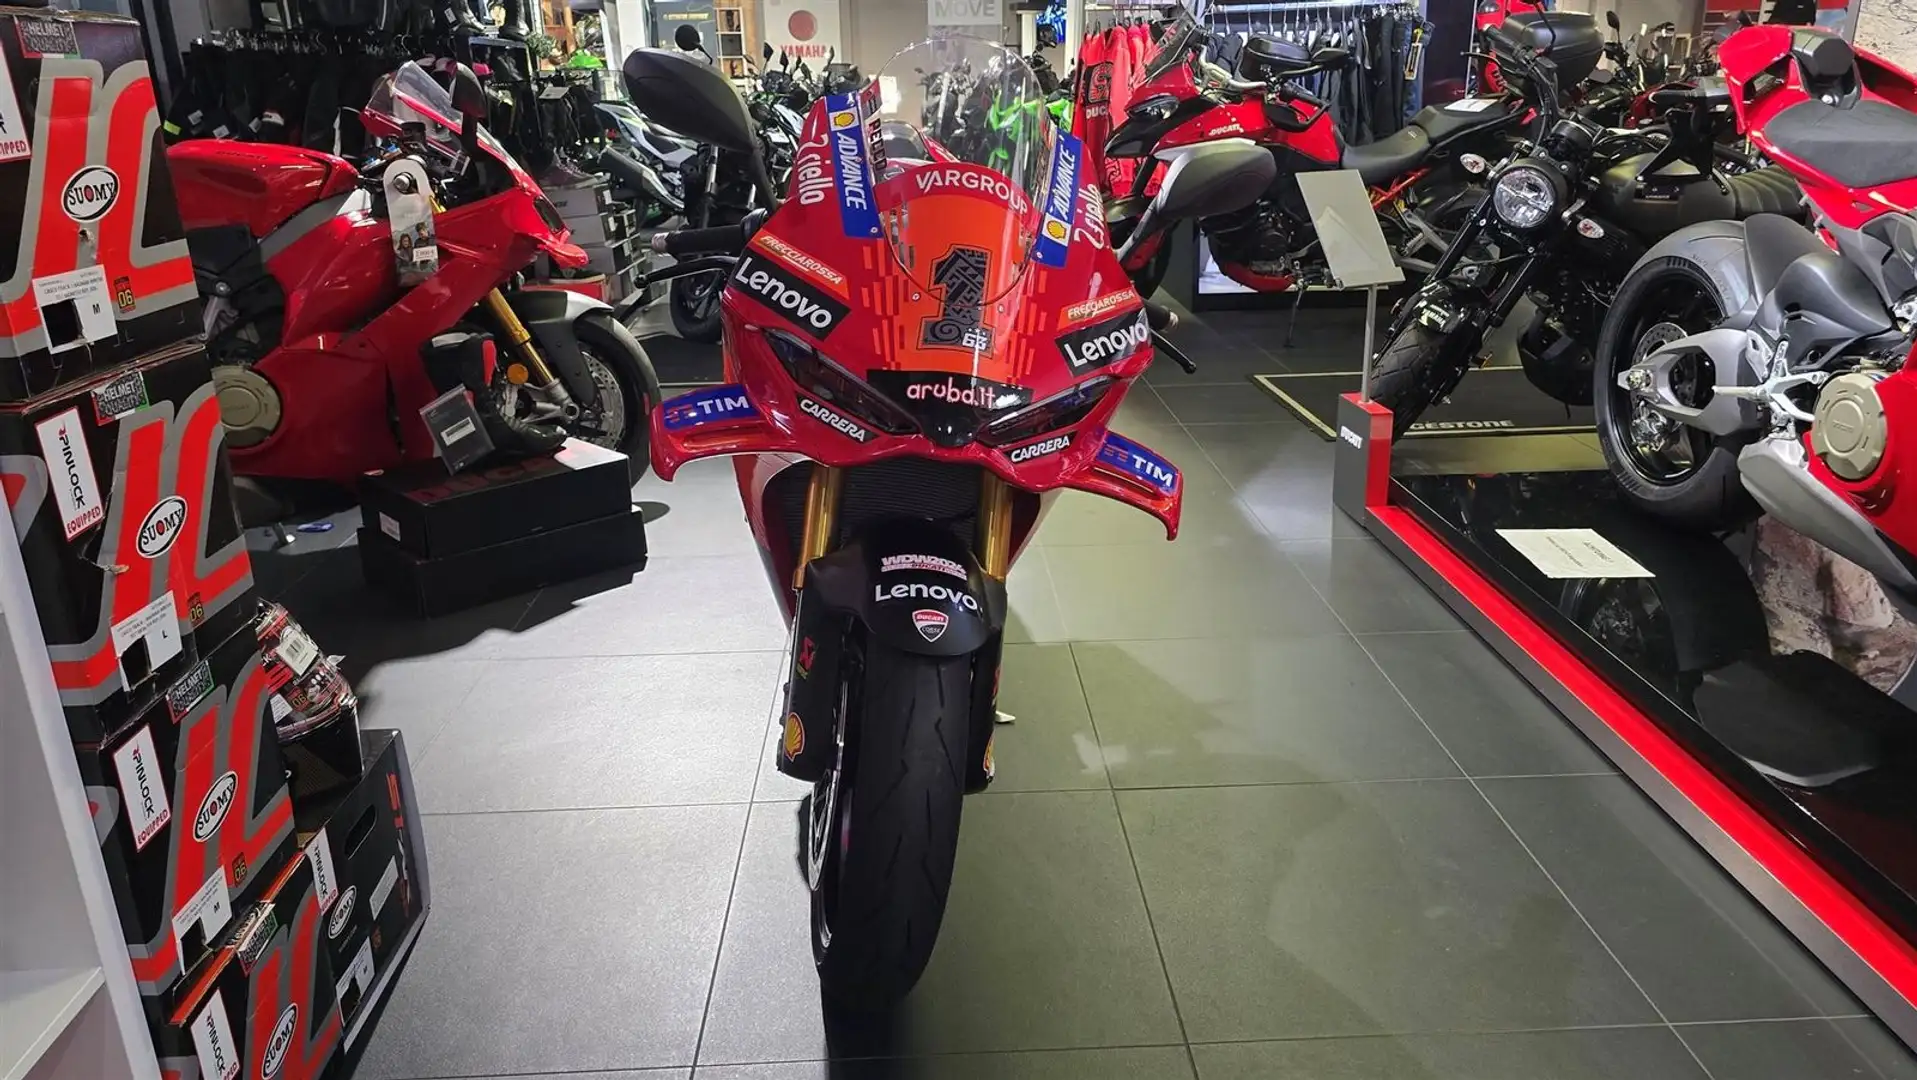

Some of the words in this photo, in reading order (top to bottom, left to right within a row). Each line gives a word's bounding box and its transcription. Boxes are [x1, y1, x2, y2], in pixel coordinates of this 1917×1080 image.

[935, 0, 995, 17] MOVE
[1086, 106, 1108, 119] DUC
[0, 141, 26, 155] IPPED
[836, 132, 867, 210] ADVANCE
[1053, 145, 1075, 220] ADVANCE
[68, 182, 114, 205] SUOMY
[916, 171, 1028, 214] VARGROUP
[760, 235, 842, 284] FRECCIAROSSA
[92, 303, 101, 315] M
[117, 289, 137, 307] 06
[735, 256, 832, 329] Lenovo
[1064, 322, 1148, 368] Lenovo
[104, 381, 136, 401] HELMET
[697, 395, 750, 415] TIM
[906, 376, 996, 409] aruba.it
[800, 398, 866, 442] CARRERA
[1409, 420, 1515, 430] GESTONE
[1011, 435, 1070, 463] CARRERA
[59, 434, 86, 509] PINLOCK
[1132, 454, 1174, 487] TIM
[66, 505, 101, 534] EQUIPPED
[141, 508, 184, 546] SUOMY
[875, 583, 978, 611] Lenovo
[162, 630, 168, 639] L
[132, 753, 155, 819] PINLOCK
[197, 781, 234, 831] SUOMY
[137, 809, 169, 845] EQUIPPED
[206, 1015, 226, 1077] PINLOCK
[265, 1012, 295, 1070] SUOMY
